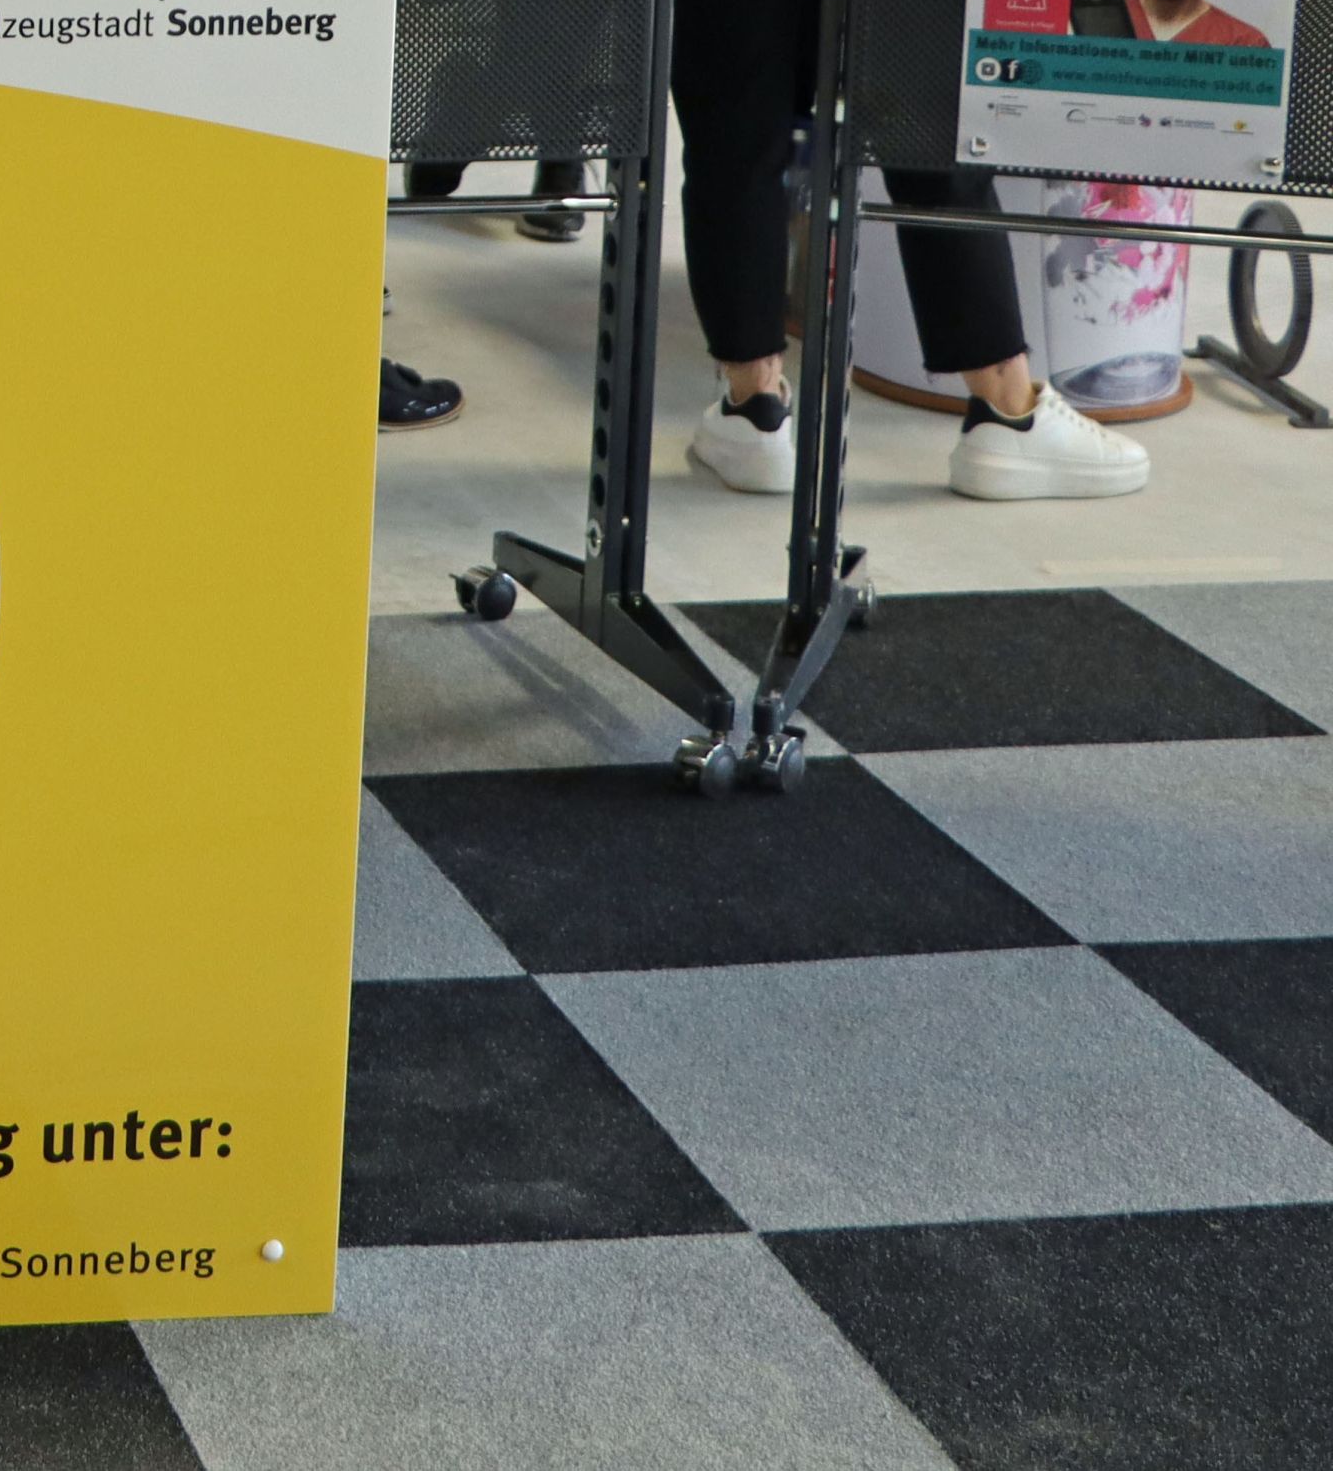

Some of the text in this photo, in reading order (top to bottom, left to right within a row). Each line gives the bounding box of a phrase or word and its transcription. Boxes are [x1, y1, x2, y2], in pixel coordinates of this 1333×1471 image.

[166, 7, 337, 41] Sonneberg
[976, 36, 1276, 69] Mehr Informationen, mehr MINT unter:
[42, 1109, 233, 1164] unter:
